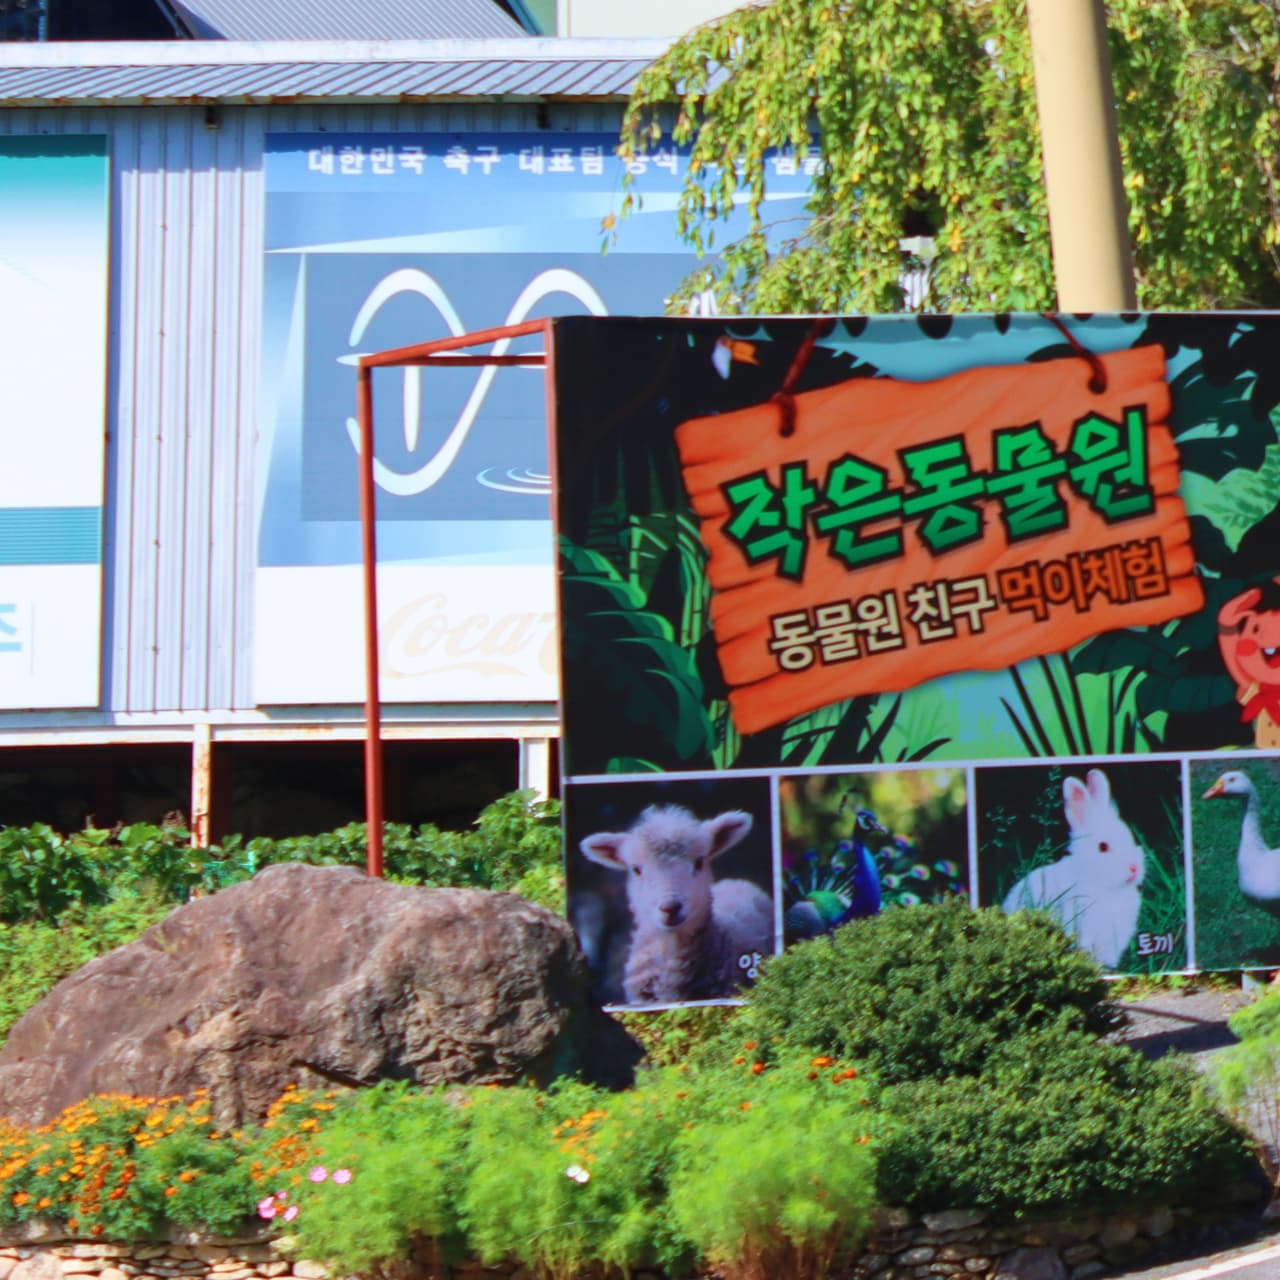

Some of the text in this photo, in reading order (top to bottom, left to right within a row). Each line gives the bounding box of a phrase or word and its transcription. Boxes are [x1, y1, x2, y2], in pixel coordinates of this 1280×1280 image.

[308, 146, 427, 175] 대한민국
[443, 146, 501, 175] 축구
[519, 146, 603, 175] 대표팀
[719, 404, 1156, 581] 작은동물원
[769, 537, 1170, 672] 동물원 친구 먹이체험
[1137, 933, 1174, 955] 토끼
[739, 952, 762, 979] 양
